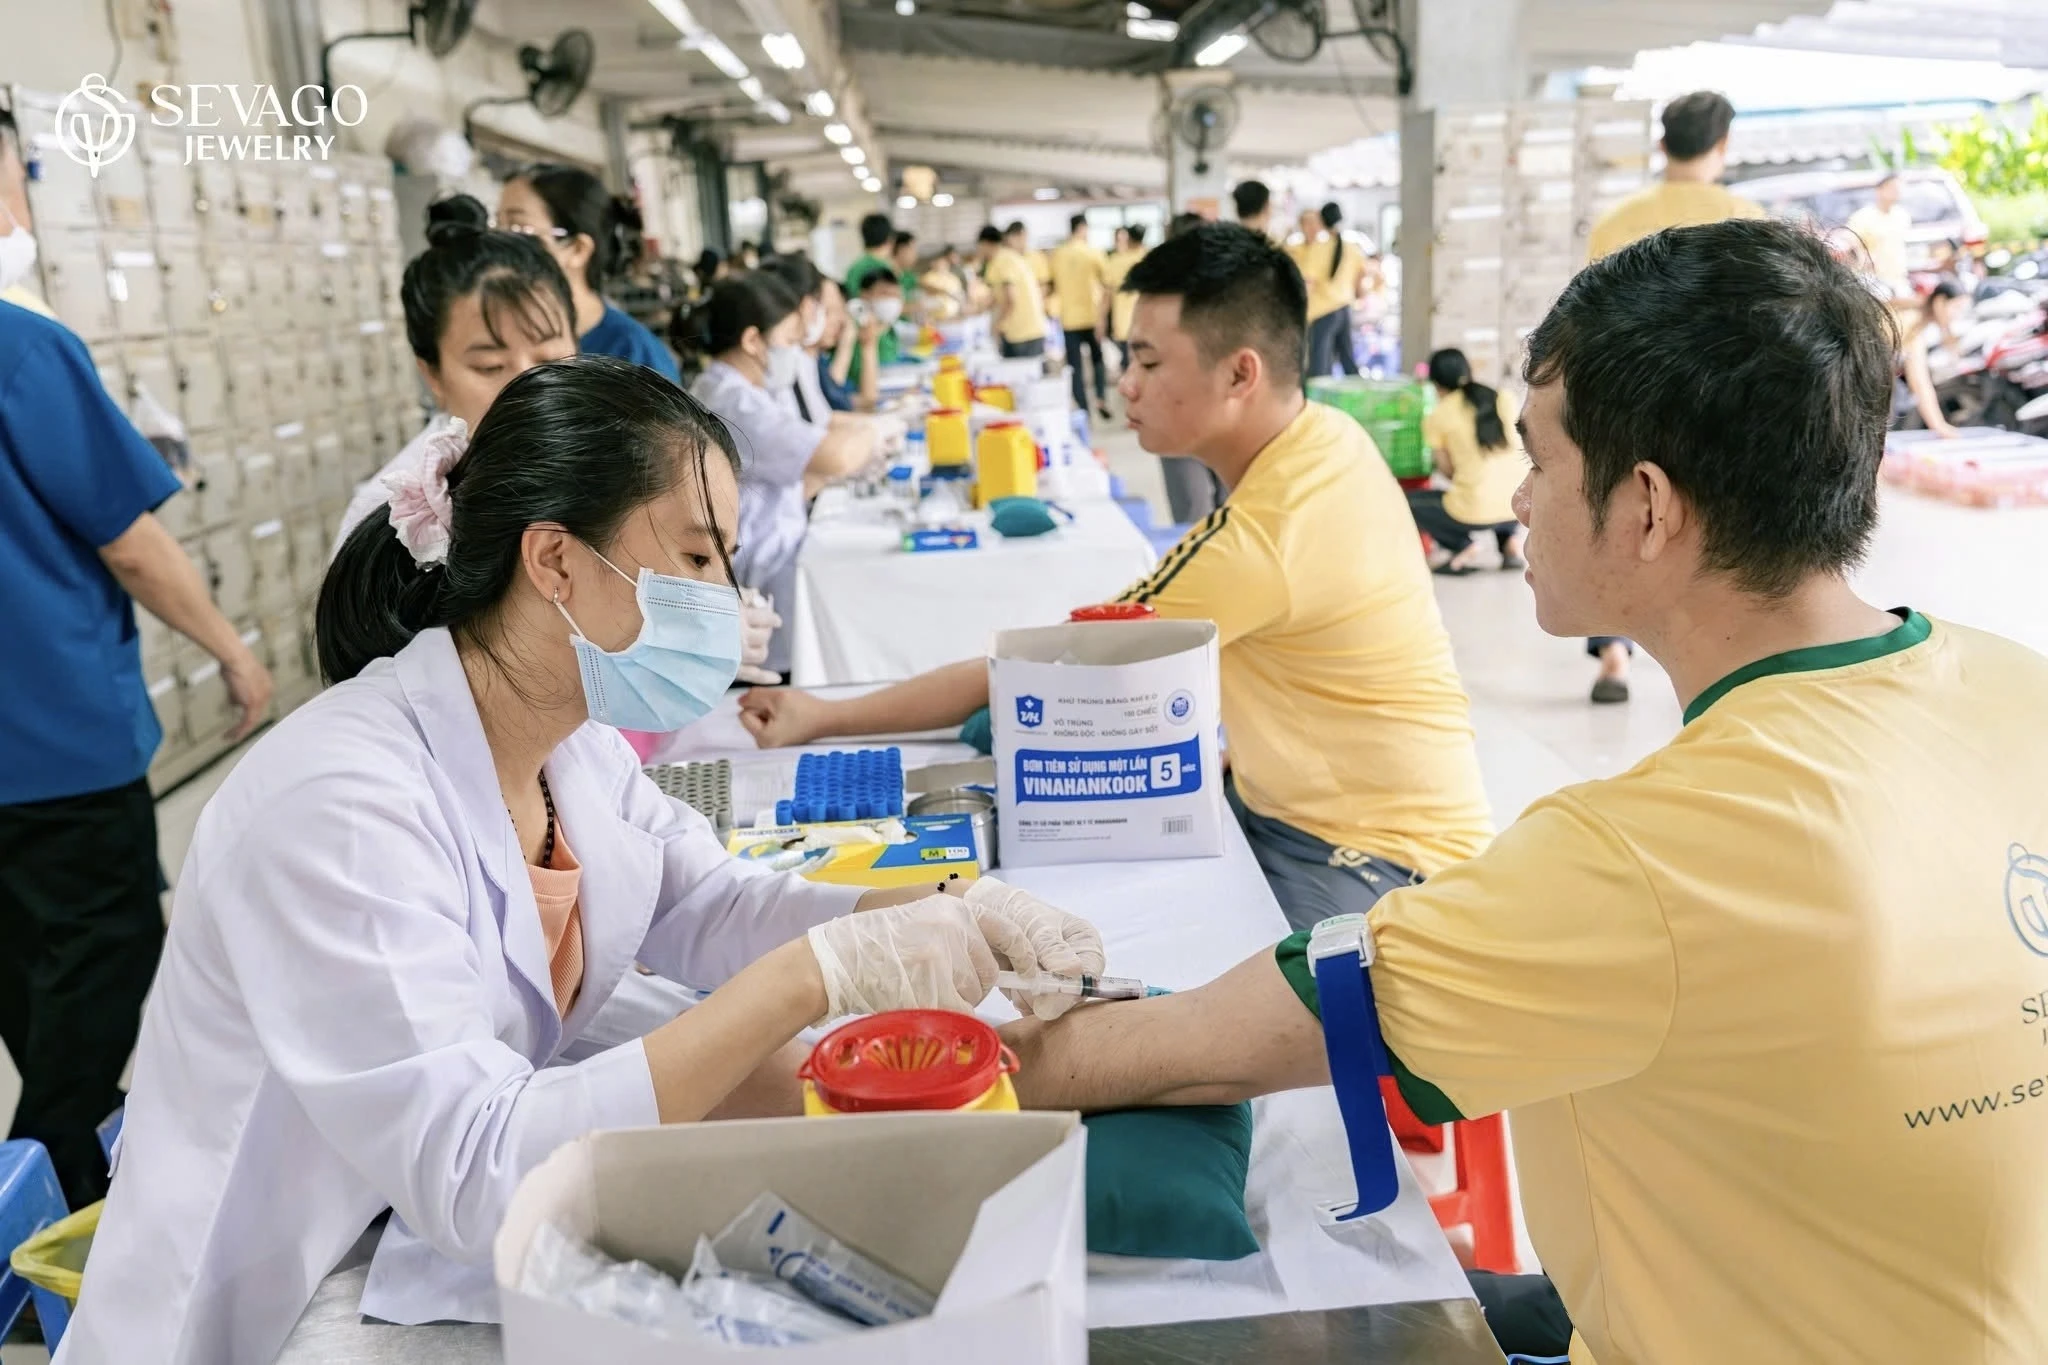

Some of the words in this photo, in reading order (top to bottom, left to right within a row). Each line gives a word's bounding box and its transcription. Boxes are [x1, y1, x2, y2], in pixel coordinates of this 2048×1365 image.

[1160, 760, 1173, 782] 5
[1022, 774, 1148, 796] VINAHANKOOK
[1903, 1075, 2048, 1129] www.se
